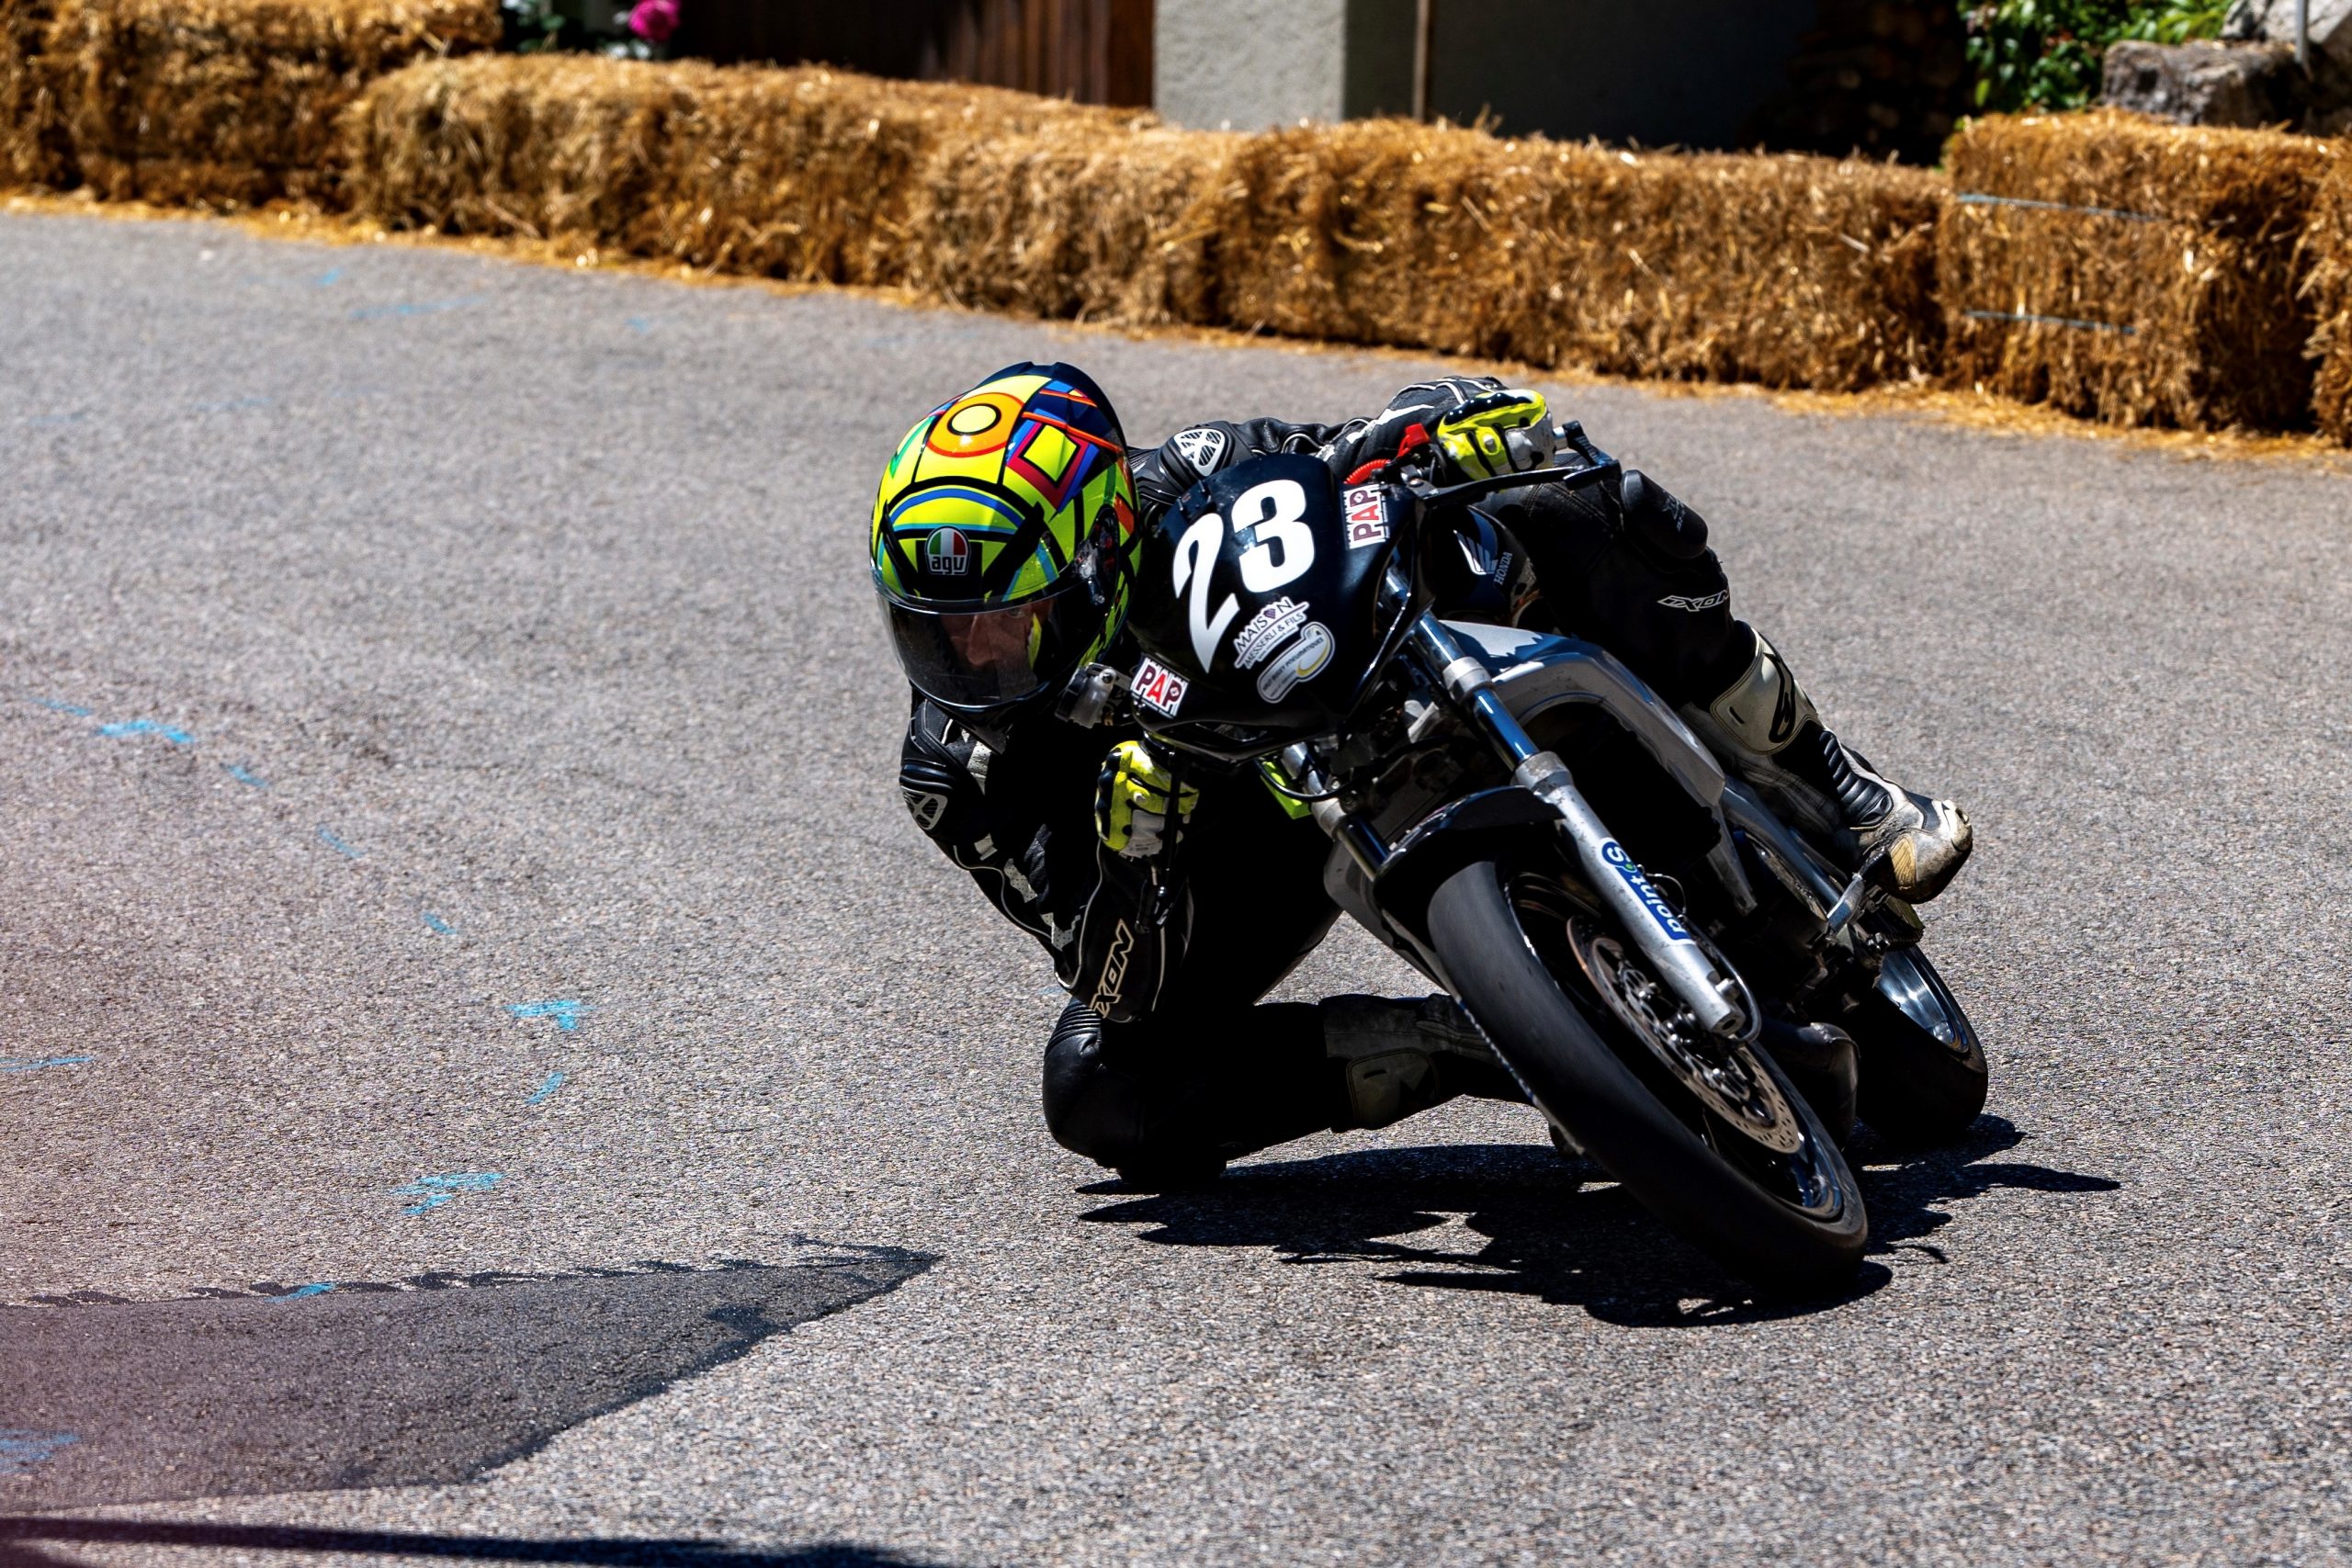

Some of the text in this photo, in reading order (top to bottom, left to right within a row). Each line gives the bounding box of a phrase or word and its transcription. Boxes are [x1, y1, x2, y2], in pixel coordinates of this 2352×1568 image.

[1349, 489, 1382, 542] PAP
[930, 556, 966, 575] agv
[1172, 479, 1315, 674] 23
[1493, 551, 1513, 586] HONDA
[1244, 629, 1278, 667] MESSERLI
[1284, 612, 1304, 626] FILS
[1136, 664, 1182, 708] PAP
[1630, 875, 1687, 934] point
